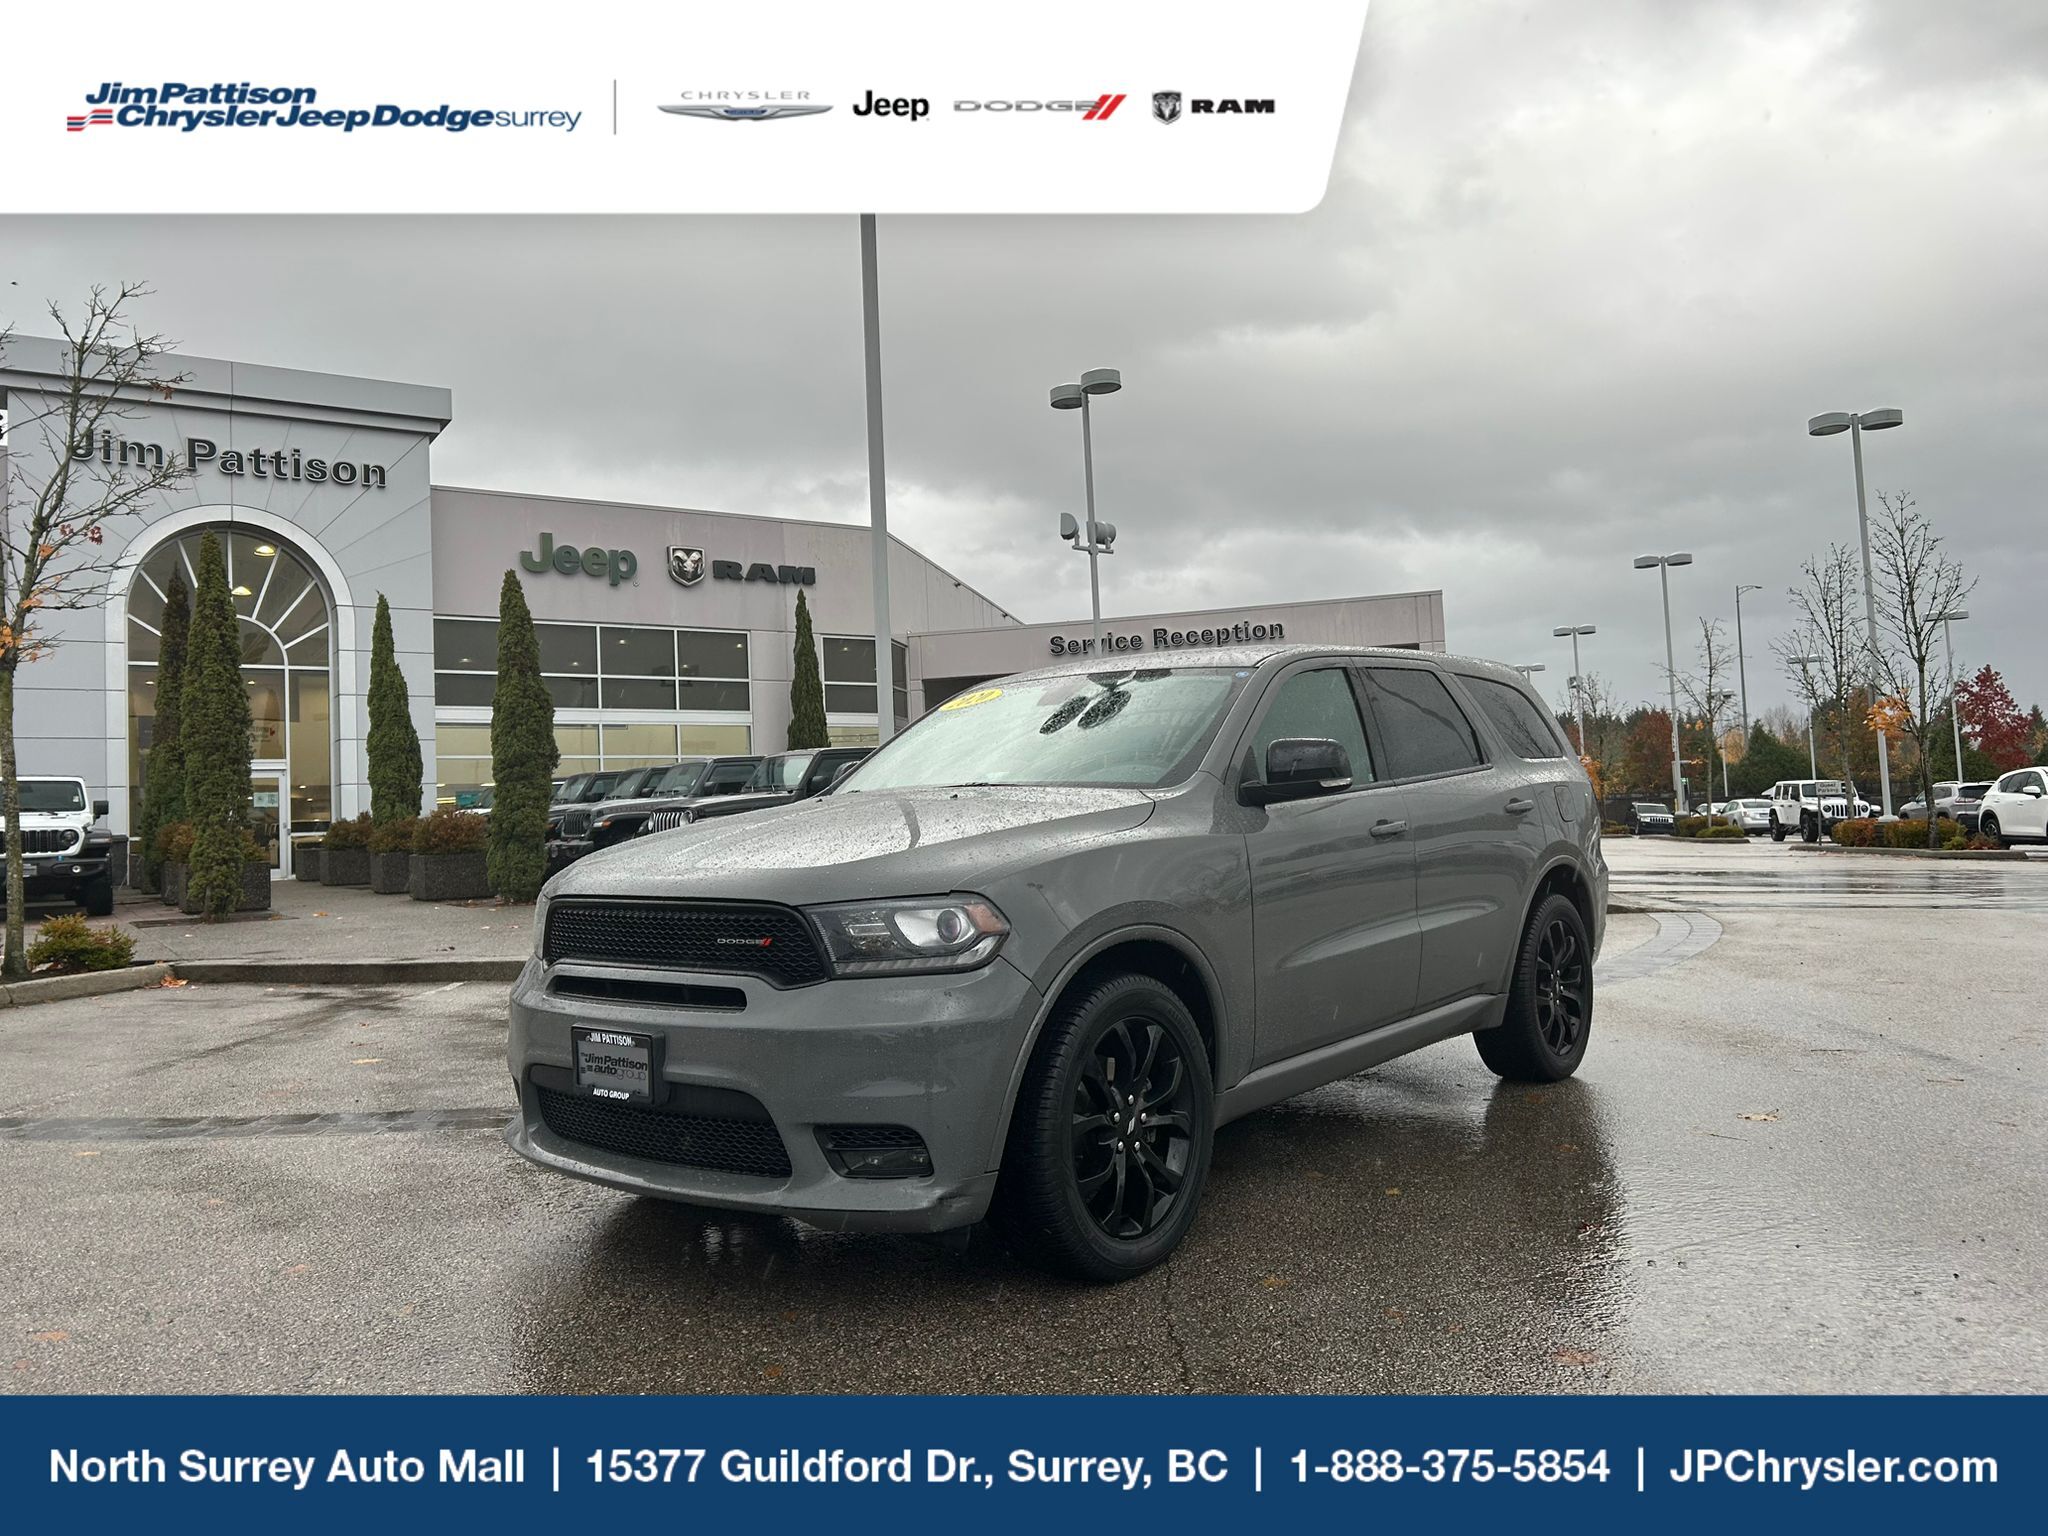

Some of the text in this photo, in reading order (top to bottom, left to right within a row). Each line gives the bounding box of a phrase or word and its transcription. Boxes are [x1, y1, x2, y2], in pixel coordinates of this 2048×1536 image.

[70, 427, 388, 487] Jim Pattison
[519, 532, 638, 587] Jeep
[712, 559, 816, 586] RAM
[1152, 620, 1285, 647] Reception
[589, 1032, 632, 1047] JIM PATTISON
[593, 1088, 630, 1100] AUTO GROUP
